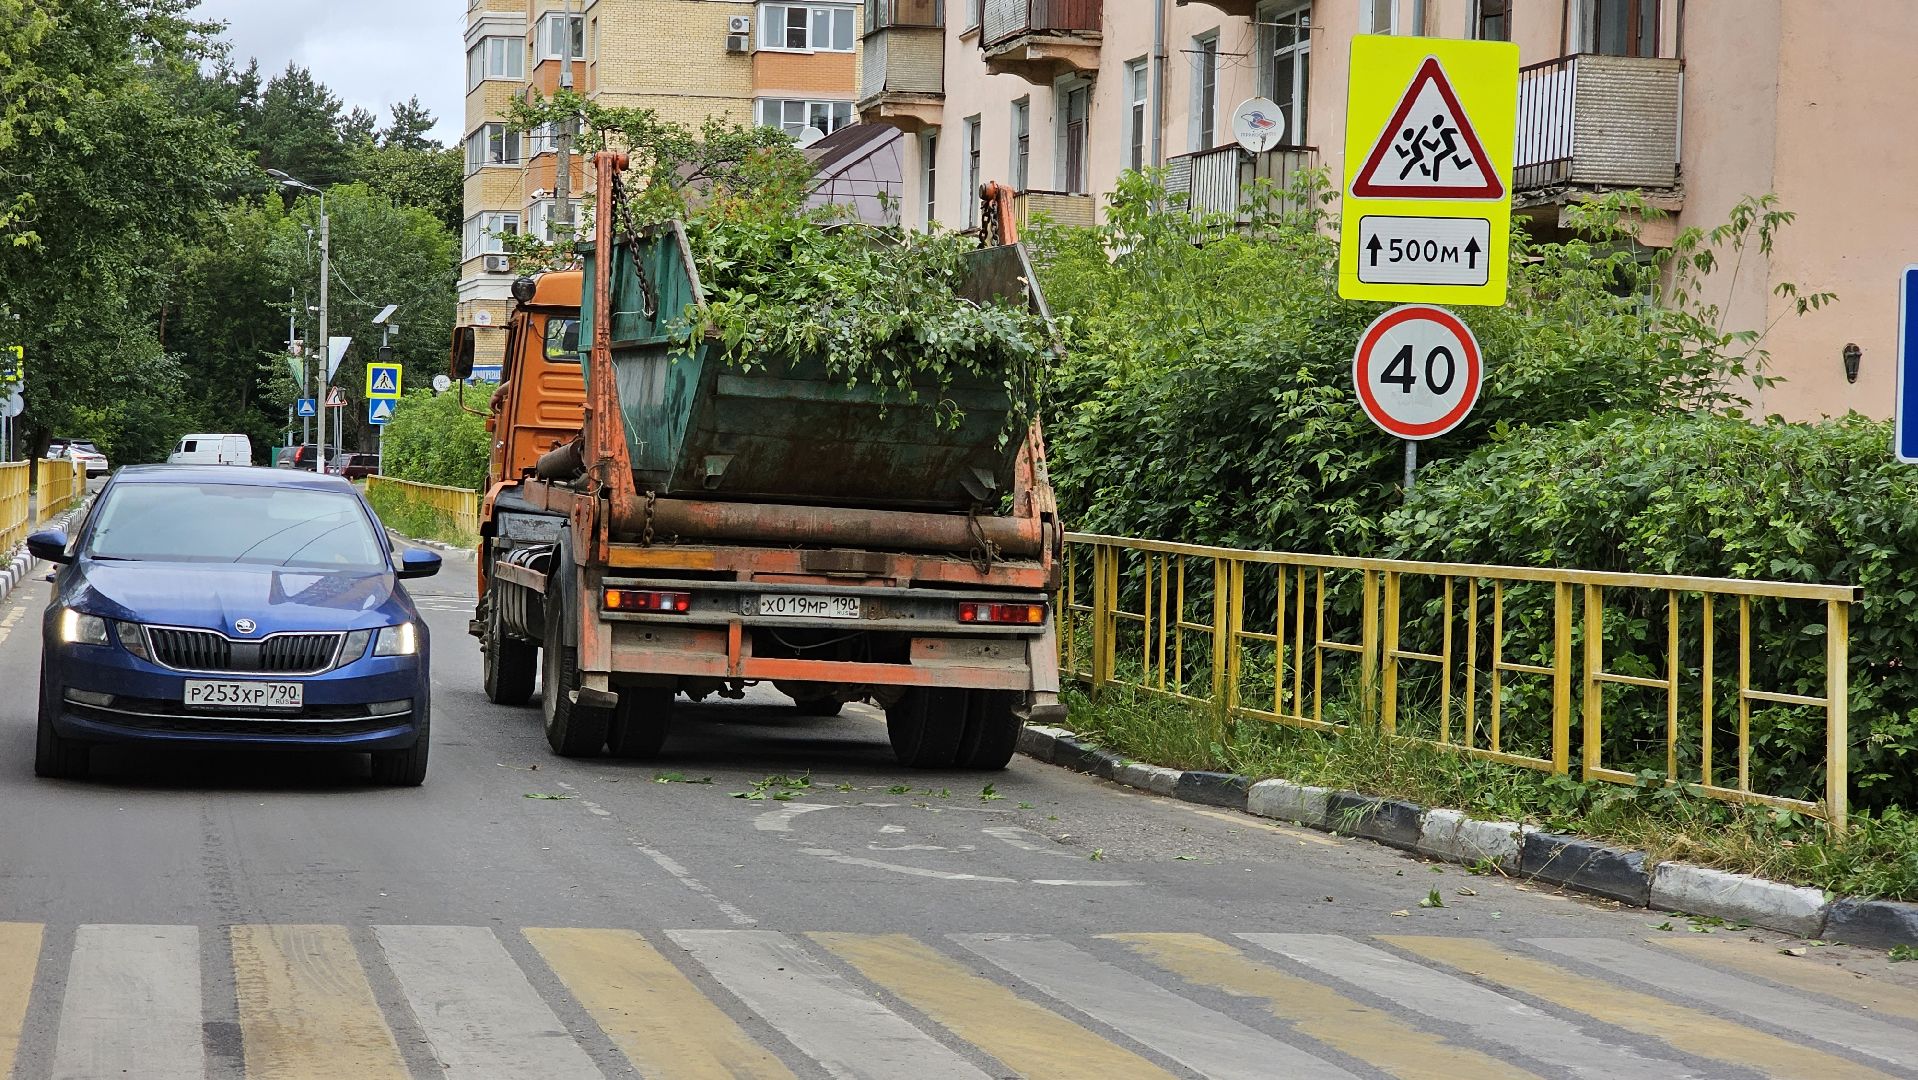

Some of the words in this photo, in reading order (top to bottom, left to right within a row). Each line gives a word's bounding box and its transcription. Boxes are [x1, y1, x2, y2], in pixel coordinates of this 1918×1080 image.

[1380, 344, 1455, 395] 40
[833, 598, 856, 611] 190
[191, 684, 264, 703] Р253ХР
[269, 685, 297, 699] 790
